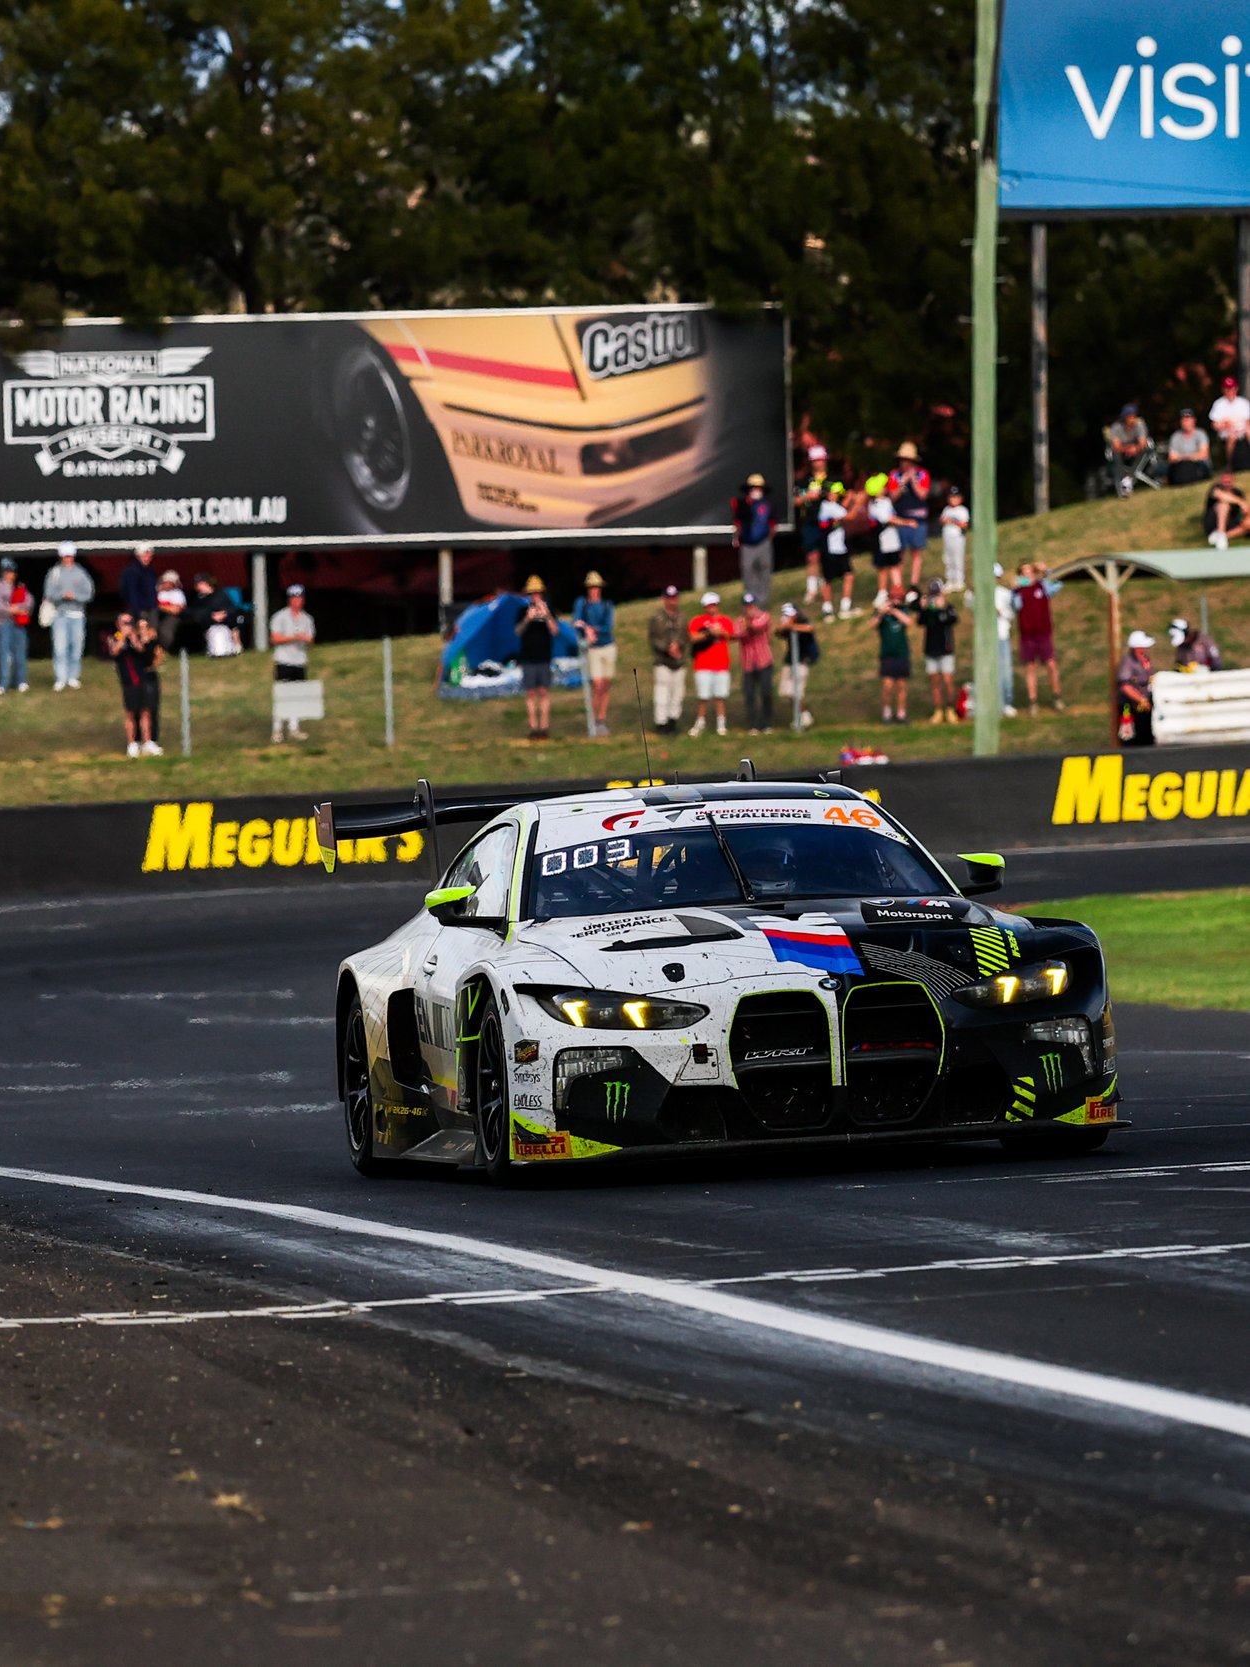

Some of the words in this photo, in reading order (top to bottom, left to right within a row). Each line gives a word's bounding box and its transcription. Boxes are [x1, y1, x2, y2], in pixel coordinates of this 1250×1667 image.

[1064, 35, 1250, 141] visi
[61, 356, 156, 374] NATIONAL
[15, 386, 104, 427] MOTOR
[109, 384, 204, 426] RACING
[67, 428, 152, 449] MUSEUM
[62, 460, 159, 477] BATHURST
[695, 807, 812, 816] INTERCONTINENTAL
[720, 812, 812, 820] CHALLENGE
[823, 806, 881, 828] 46
[541, 838, 631, 877] 003
[583, 917, 631, 932] UNITED
[638, 914, 652, 922] BY
[876, 909, 953, 921] Motorsport
